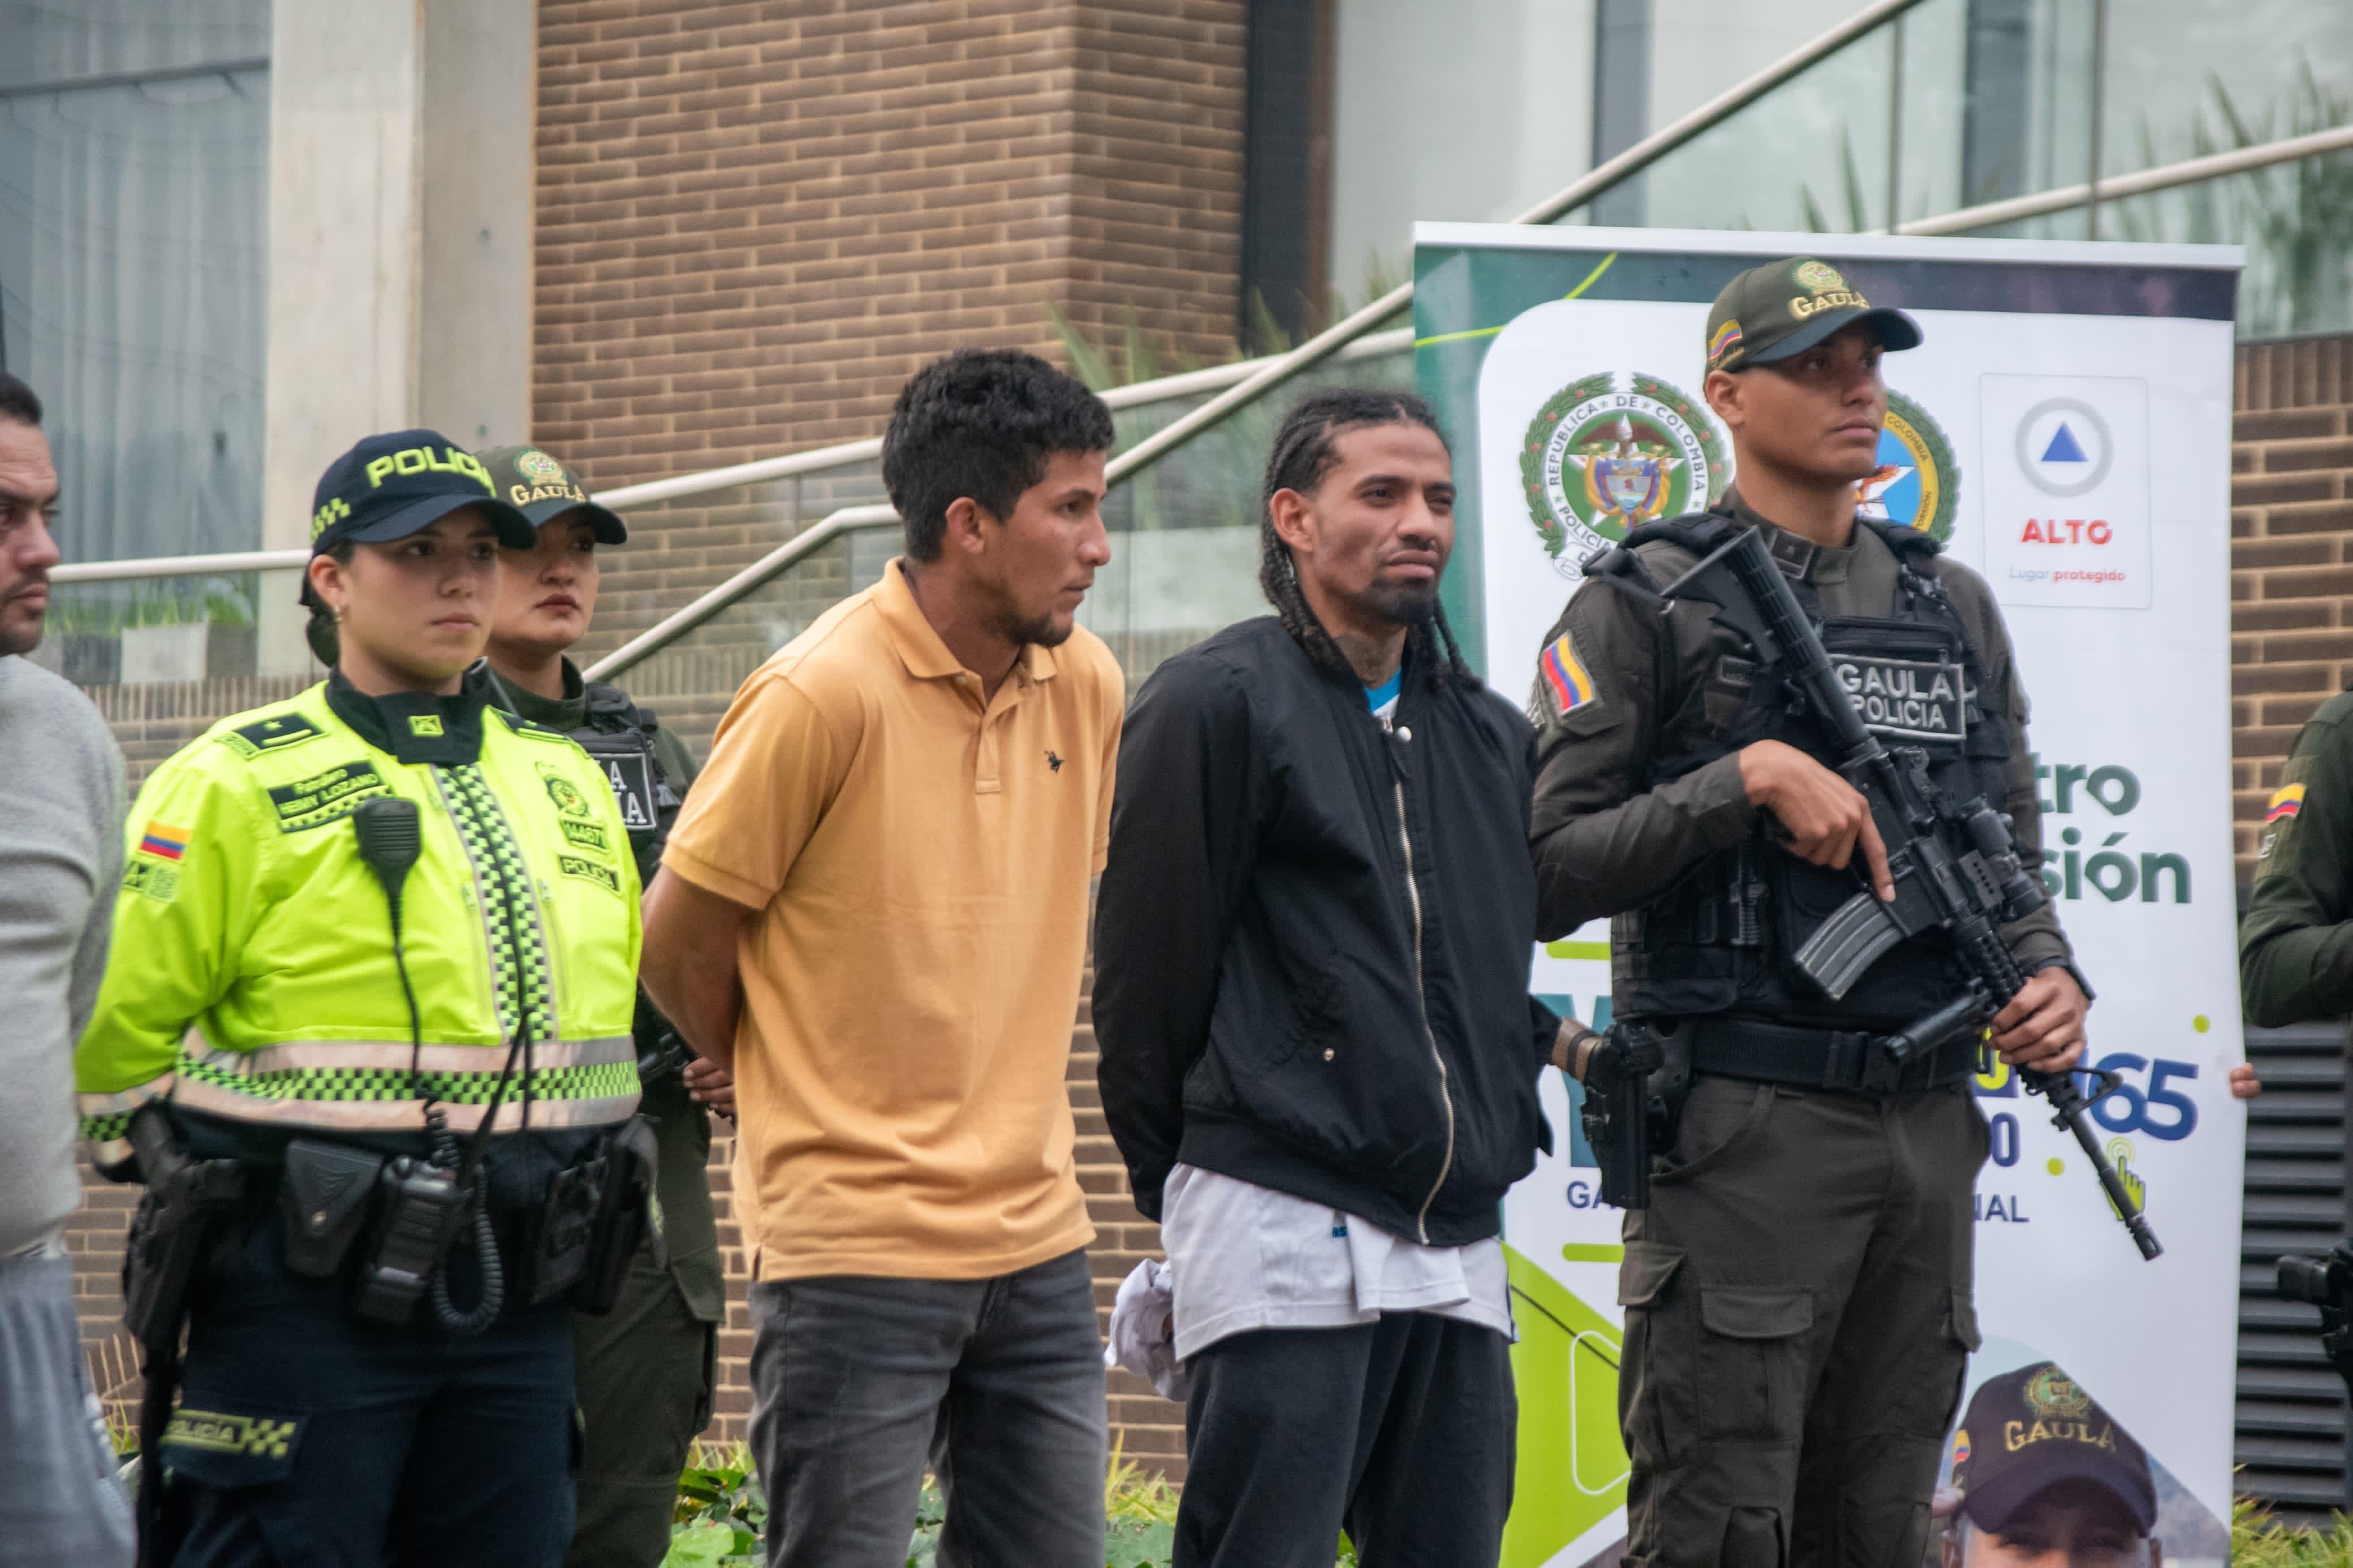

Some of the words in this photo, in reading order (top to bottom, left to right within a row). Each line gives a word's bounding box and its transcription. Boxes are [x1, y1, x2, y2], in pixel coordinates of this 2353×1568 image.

[1788, 291, 1871, 320] GAULA
[1616, 395, 1639, 408] DE
[1656, 405, 1706, 491] COLOMBIA
[1887, 416, 1929, 462] COLOMBIA
[510, 483, 587, 507] GAULA
[2021, 517, 2114, 545] ALTO
[2009, 565, 2050, 582] Lugar
[2054, 568, 2127, 584] protegido
[1837, 663, 1955, 702] GAULA
[1848, 694, 1947, 729] POLICIA
[2004, 1419, 2117, 1453] GAULA
